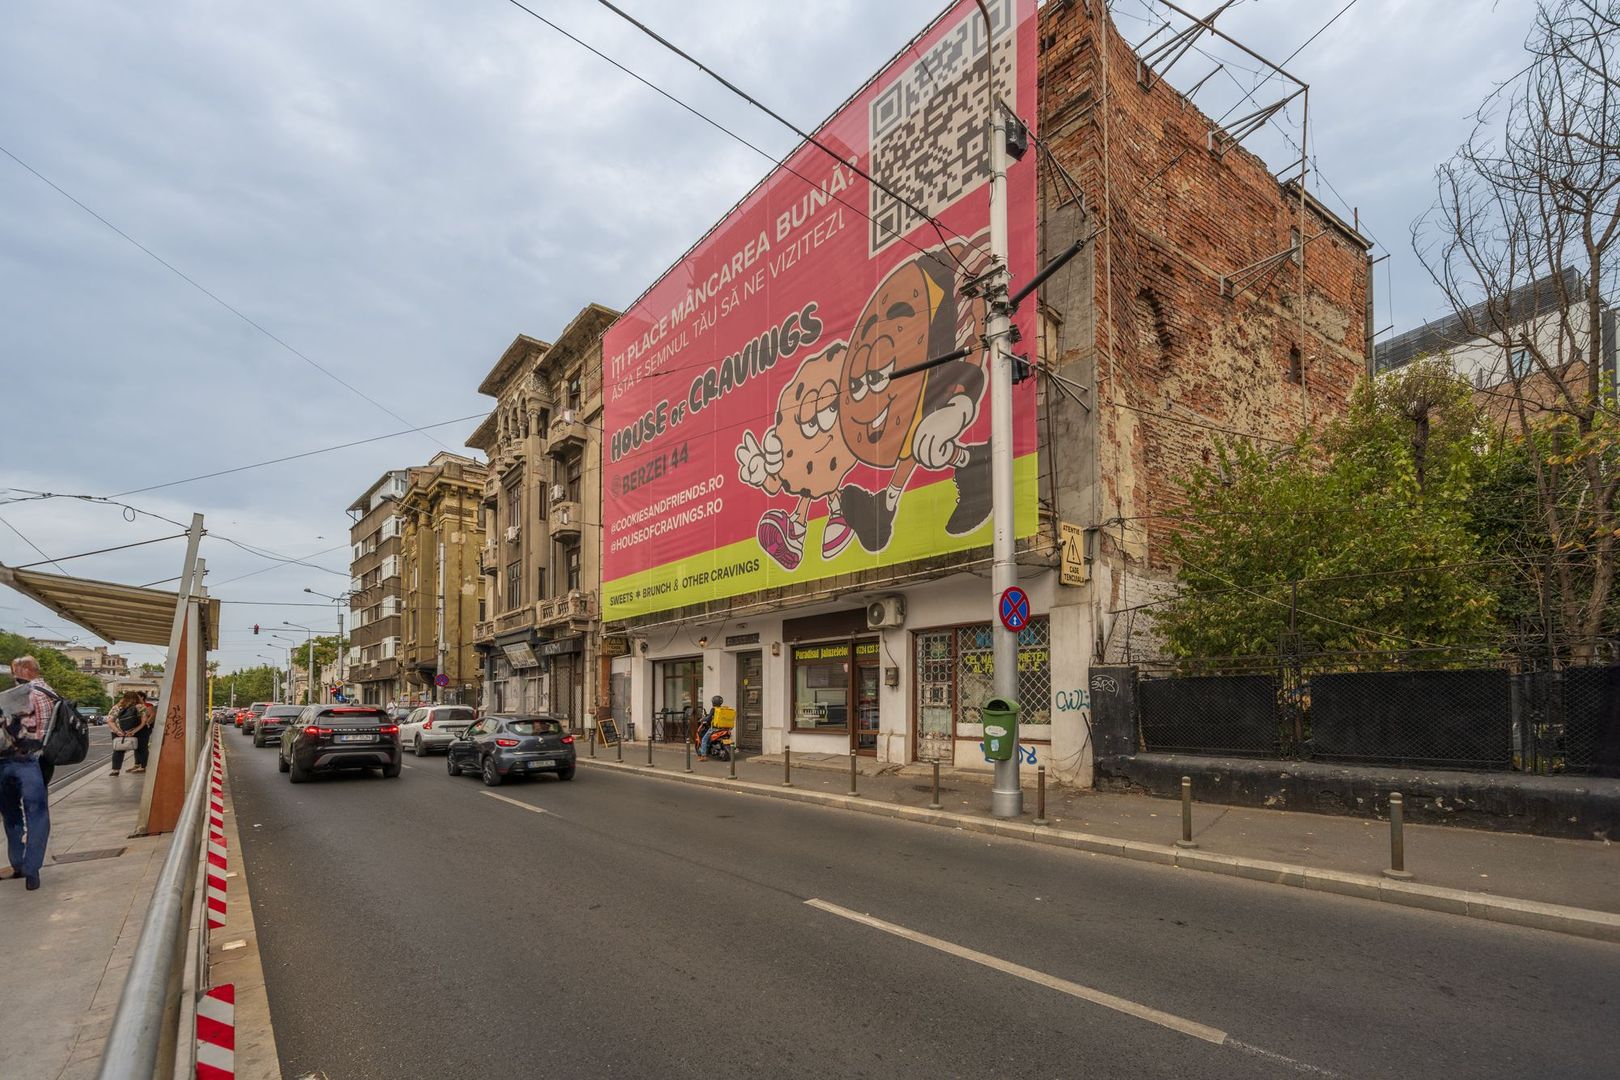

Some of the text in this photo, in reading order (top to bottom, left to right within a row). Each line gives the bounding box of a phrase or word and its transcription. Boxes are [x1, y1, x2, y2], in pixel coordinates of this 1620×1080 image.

[627, 316, 668, 365] PLACE
[671, 230, 771, 329] MÂNCAREA
[776, 155, 858, 243] BUNĂ?
[611, 374, 634, 402] ASTA
[636, 366, 643, 383] E
[644, 331, 689, 376] SEMNUL
[692, 305, 717, 338] TĂU
[721, 285, 740, 317] SĂ
[744, 268, 765, 301] NE
[611, 400, 668, 463] HOUSE
[688, 301, 823, 414] CRAVINGS
[670, 441, 688, 468] 44
[610, 474, 725, 535] @COOKIESANDFRIENDS.RO
[610, 498, 724, 554] @HOUSEOFCRAVINGS.RO
[610, 558, 760, 606] SWEETS BRUNCH & OTHER CRAVINGS
